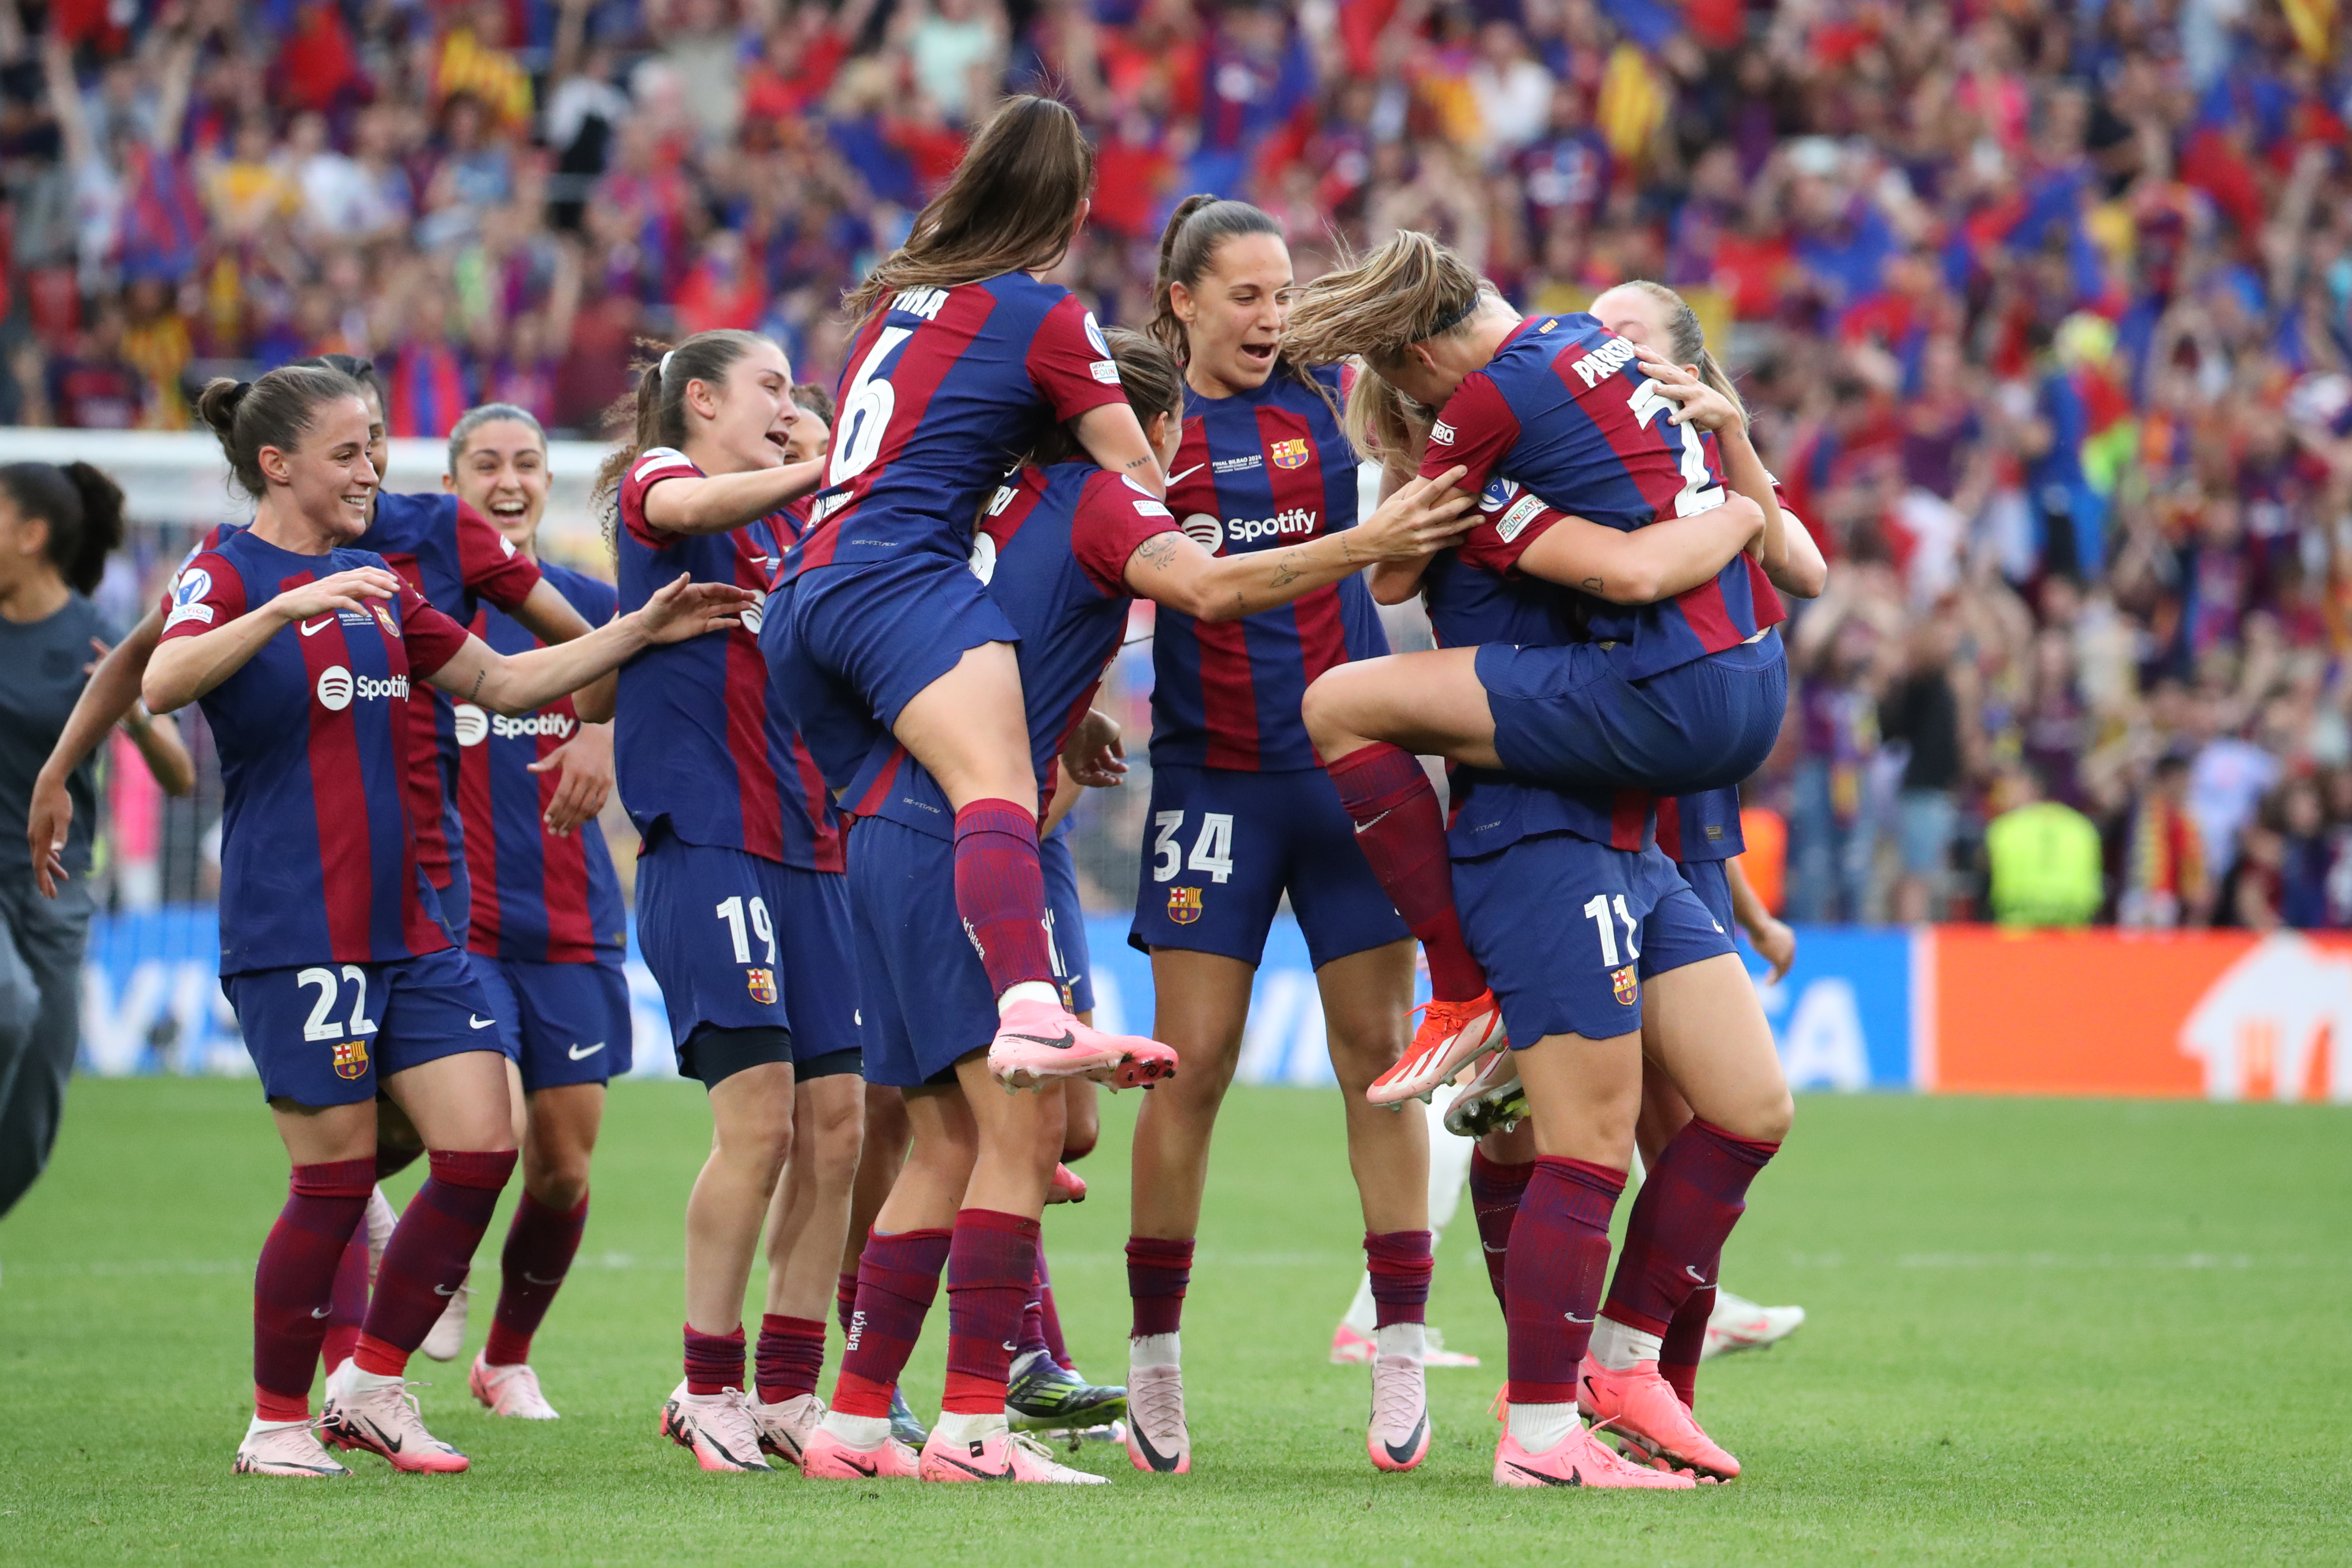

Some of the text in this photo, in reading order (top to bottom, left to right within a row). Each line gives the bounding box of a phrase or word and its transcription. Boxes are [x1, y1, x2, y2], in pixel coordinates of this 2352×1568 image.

[829, 326, 914, 487] 6
[1126, 455, 1151, 469] BRAVE
[1228, 457, 1248, 465] BILBAO
[1626, 377, 1726, 519] 2
[826, 490, 854, 509] UNHCR
[1228, 508, 1317, 543] Spotify
[357, 673, 410, 703] Spotify
[492, 712, 575, 740] Spotify
[1154, 809, 1234, 883] 34
[716, 896, 776, 965] 19
[1584, 894, 1640, 967] 11
[296, 964, 379, 1042] 22
[846, 1311, 867, 1351] BARÇA
